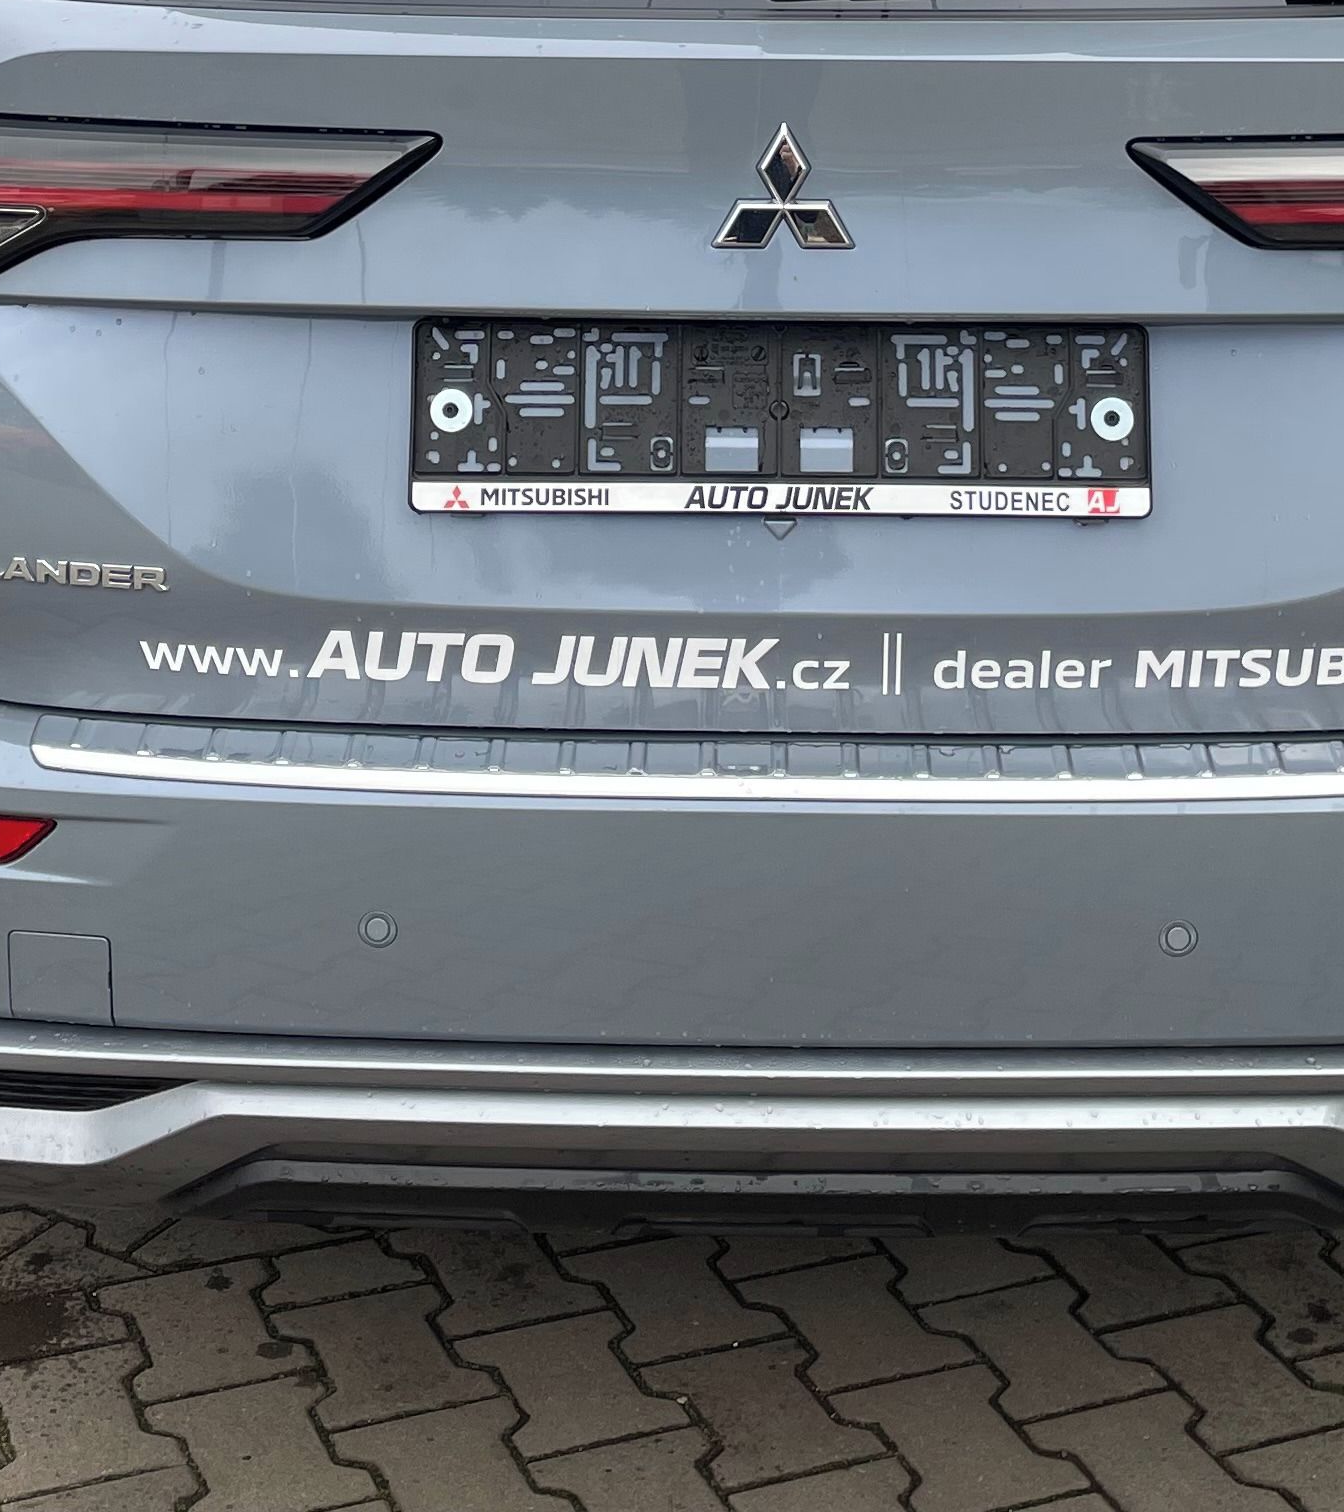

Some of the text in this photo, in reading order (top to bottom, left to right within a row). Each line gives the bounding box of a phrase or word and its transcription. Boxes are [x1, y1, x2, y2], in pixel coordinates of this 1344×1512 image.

[480, 486, 1120, 514] MITSUBISHI AUTO JUNEK STUDENEC AJ
[531, 635, 852, 690] JUNEK.cz
[933, 650, 1113, 689] dealer
